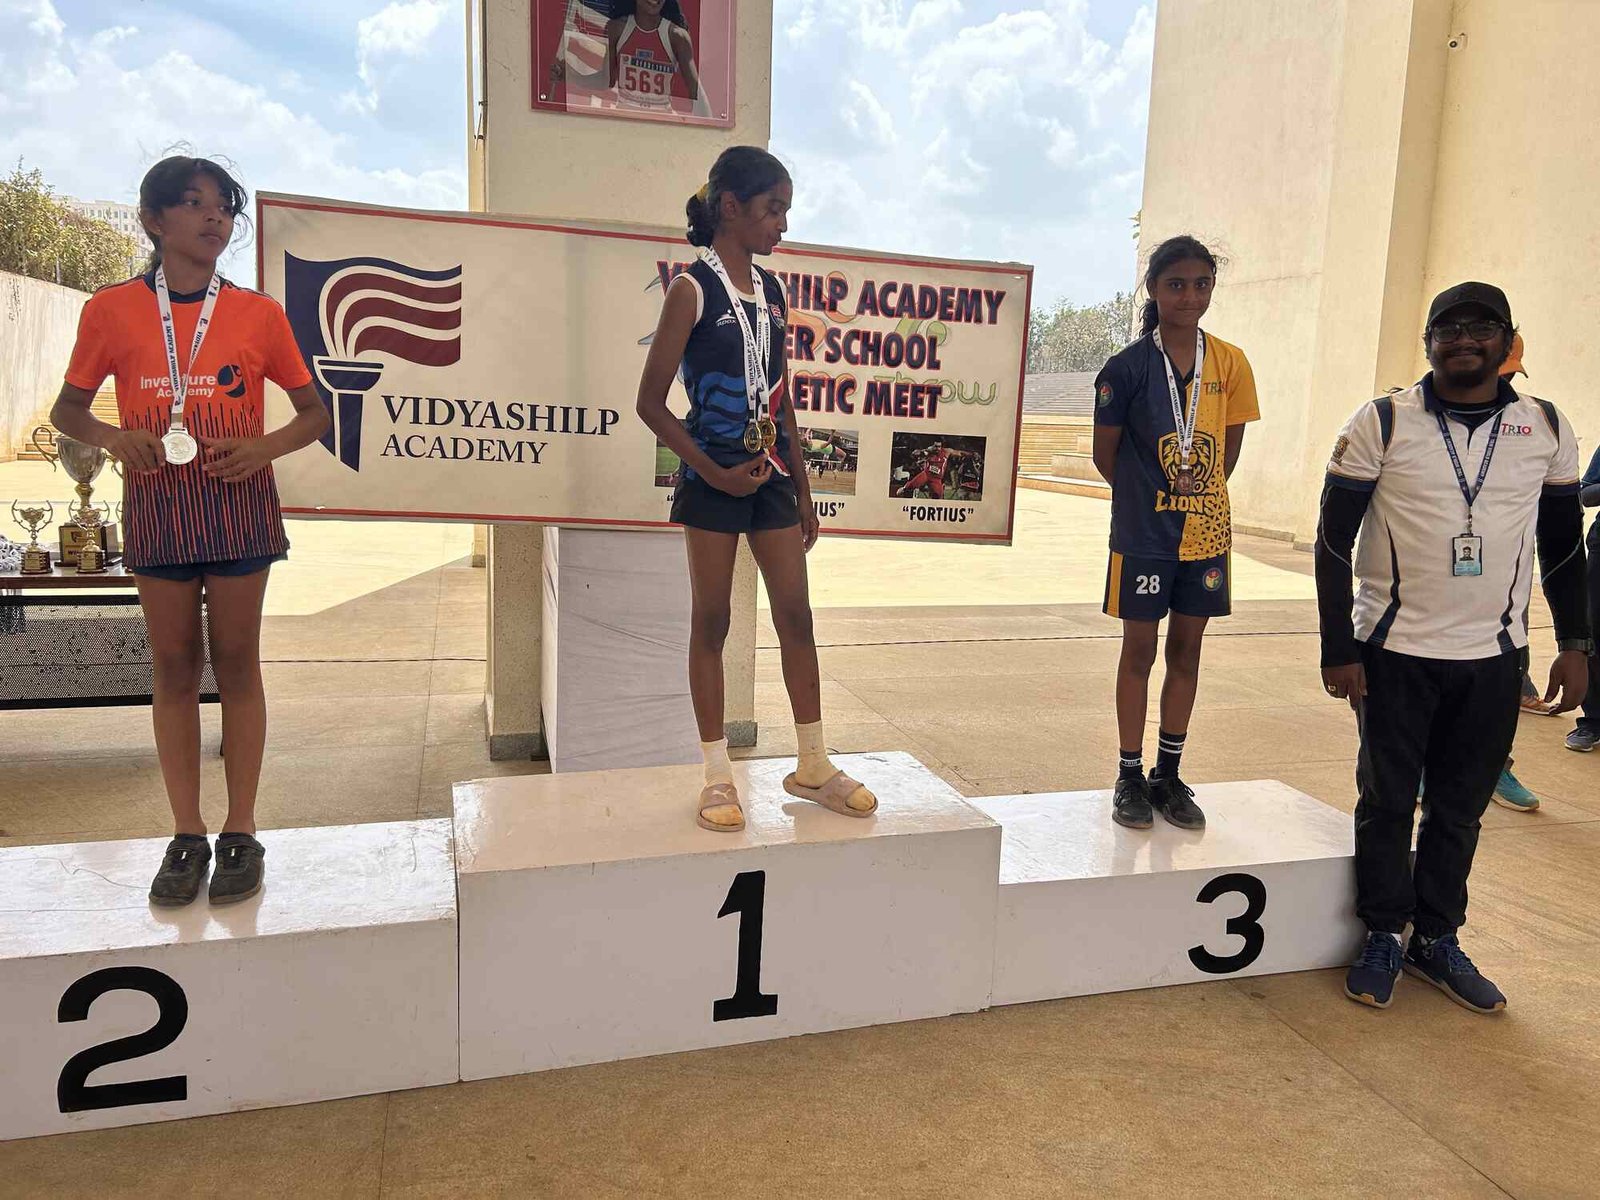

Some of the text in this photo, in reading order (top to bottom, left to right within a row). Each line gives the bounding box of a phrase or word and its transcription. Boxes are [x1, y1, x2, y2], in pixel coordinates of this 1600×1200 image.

[624, 66, 665, 95] 569
[856, 280, 1006, 325] ACADEMY
[824, 326, 941, 370] SCHOOL
[140, 373, 217, 390] Inveture
[156, 387, 215, 399] Acemy
[380, 394, 620, 436] VIDYASHILP
[862, 380, 945, 419] MEET
[1501, 423, 1532, 435] TRIO
[380, 433, 549, 464] ACADEMY
[1154, 489, 1218, 517] LIONS
[1135, 574, 1161, 595] 28
[1187, 872, 1267, 975] 3
[713, 870, 779, 1022] 1
[57, 965, 189, 1114] 2
